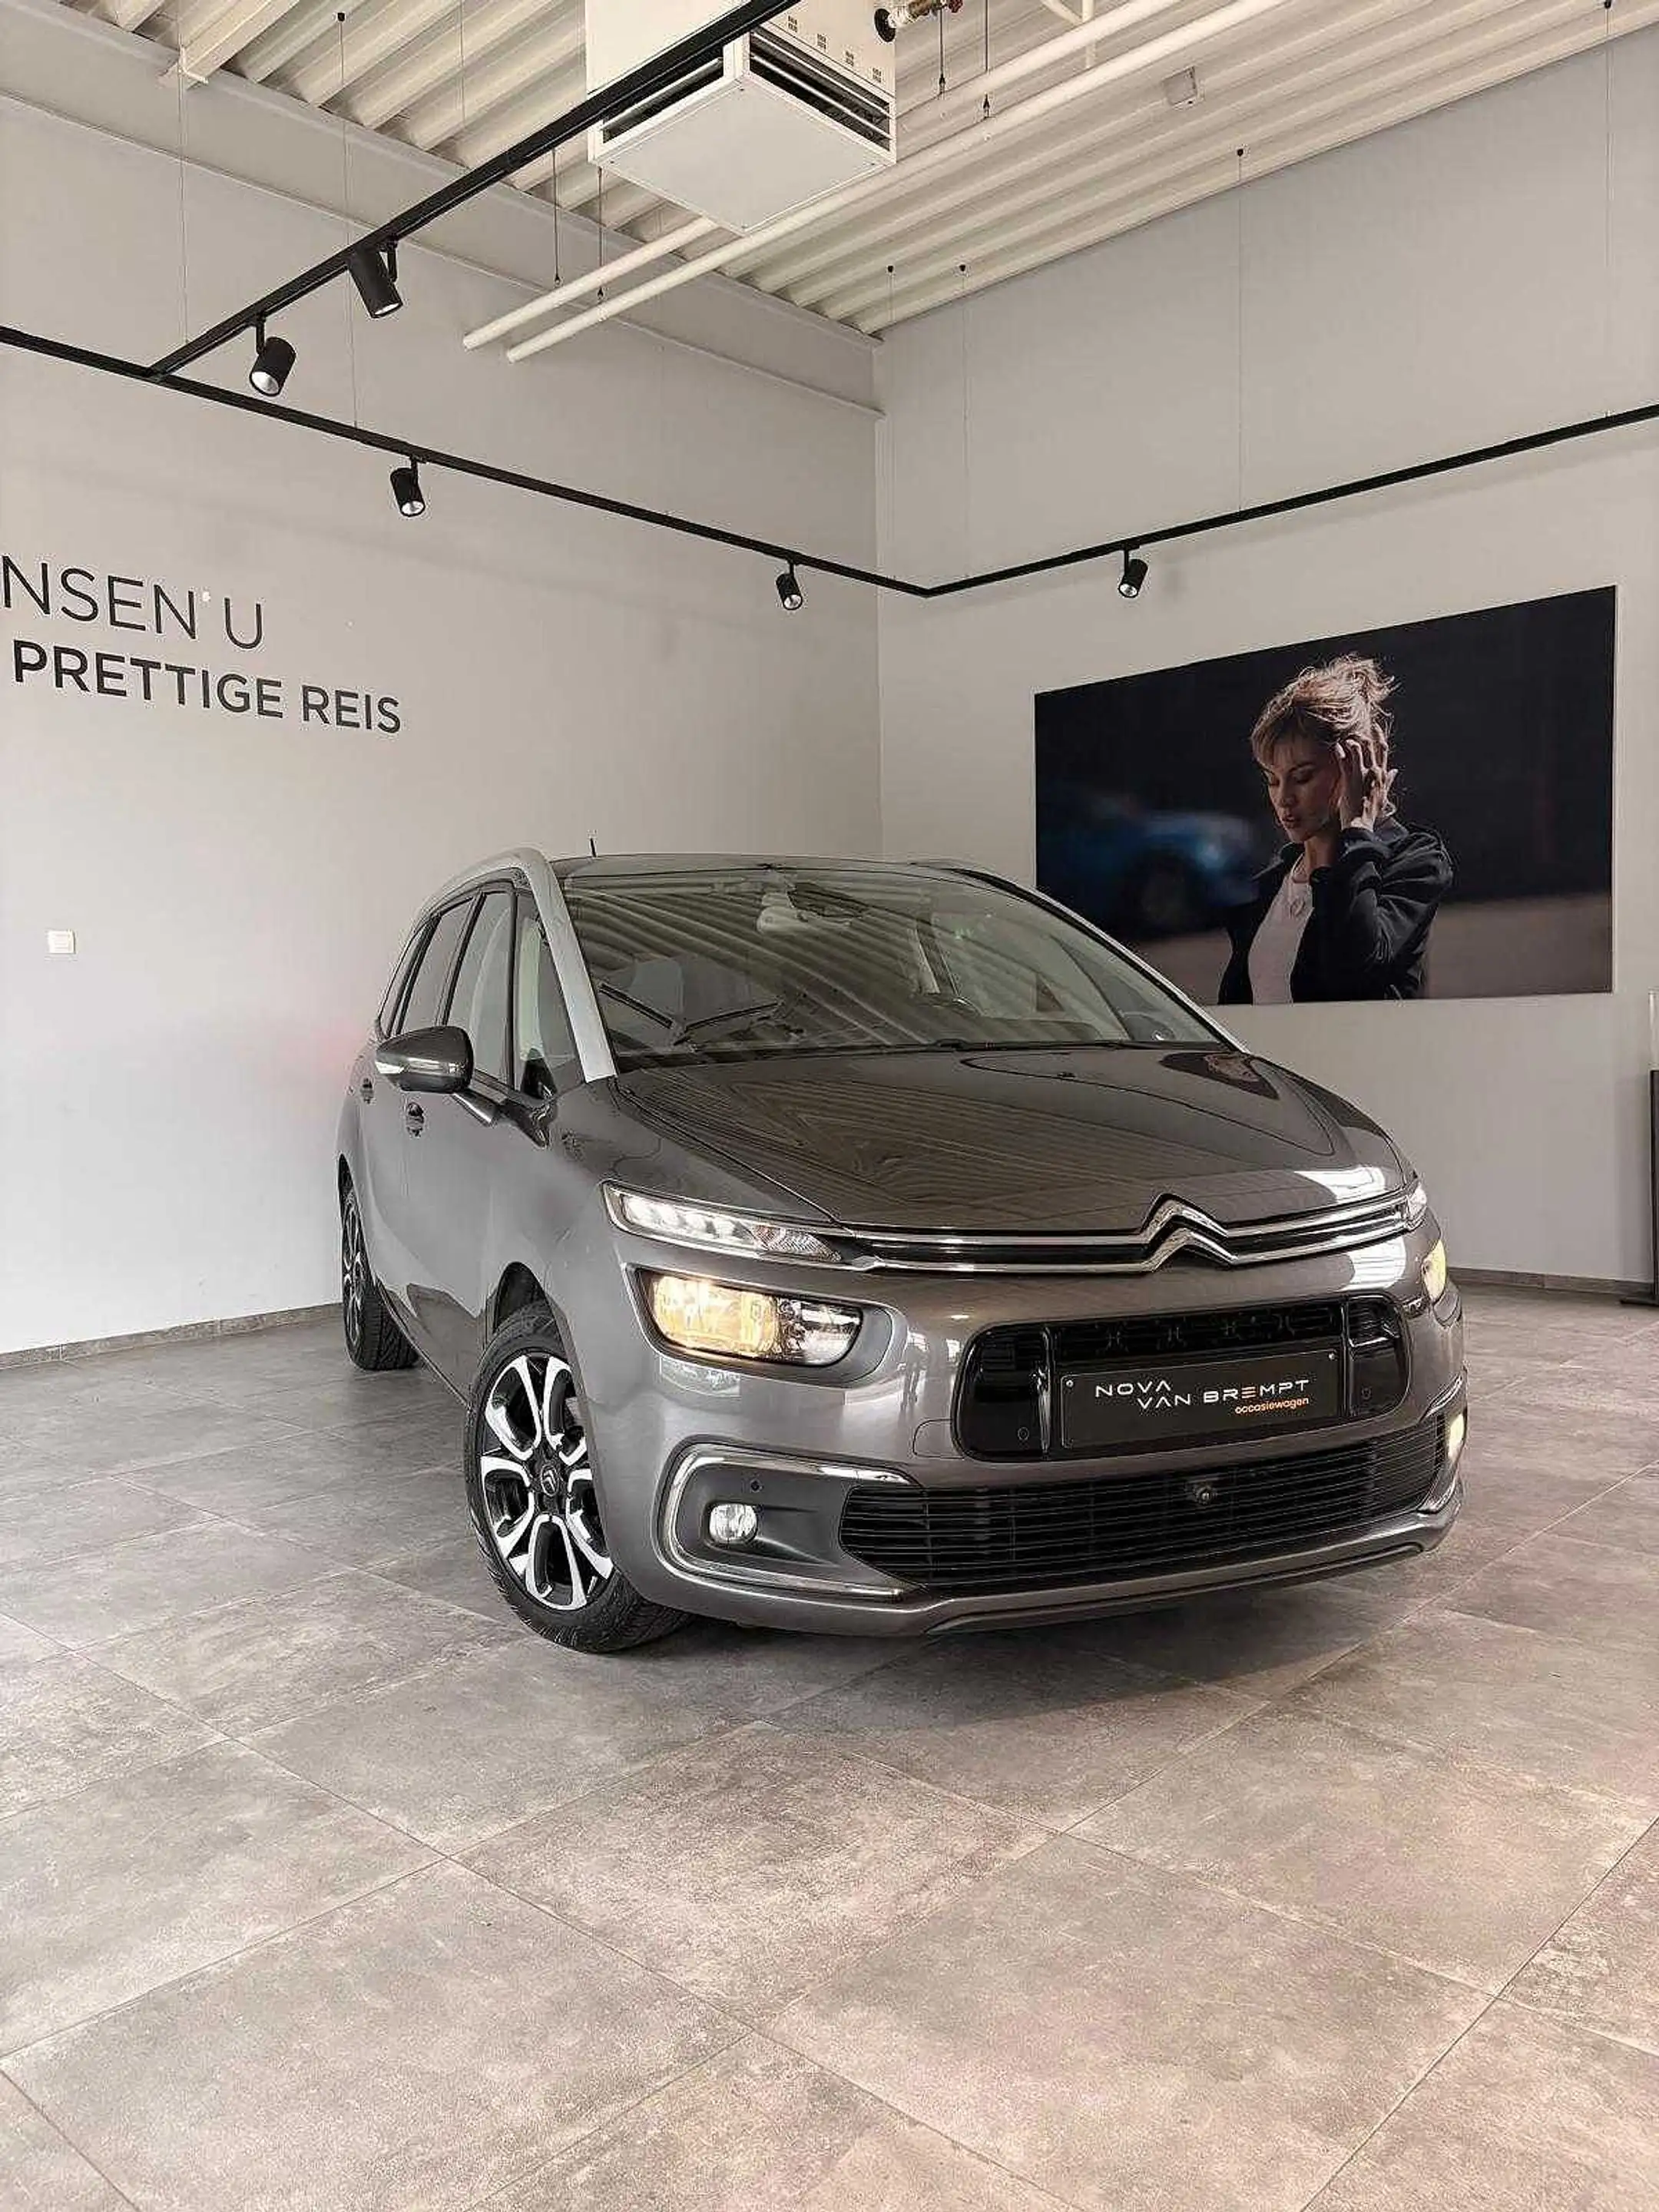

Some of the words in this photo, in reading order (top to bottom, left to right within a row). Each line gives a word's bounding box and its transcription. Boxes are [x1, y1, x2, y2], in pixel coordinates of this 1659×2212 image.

[2, 555, 197, 640] NSEN
[224, 597, 263, 650] U
[13, 639, 283, 720] PRETTIGE
[302, 684, 401, 734] REIS
[1095, 1380, 1171, 1398] NOVA
[1137, 1394, 1191, 1409] VAN
[1204, 1379, 1310, 1404] BREMPT
[1234, 1398, 1310, 1415] occasiewagen
